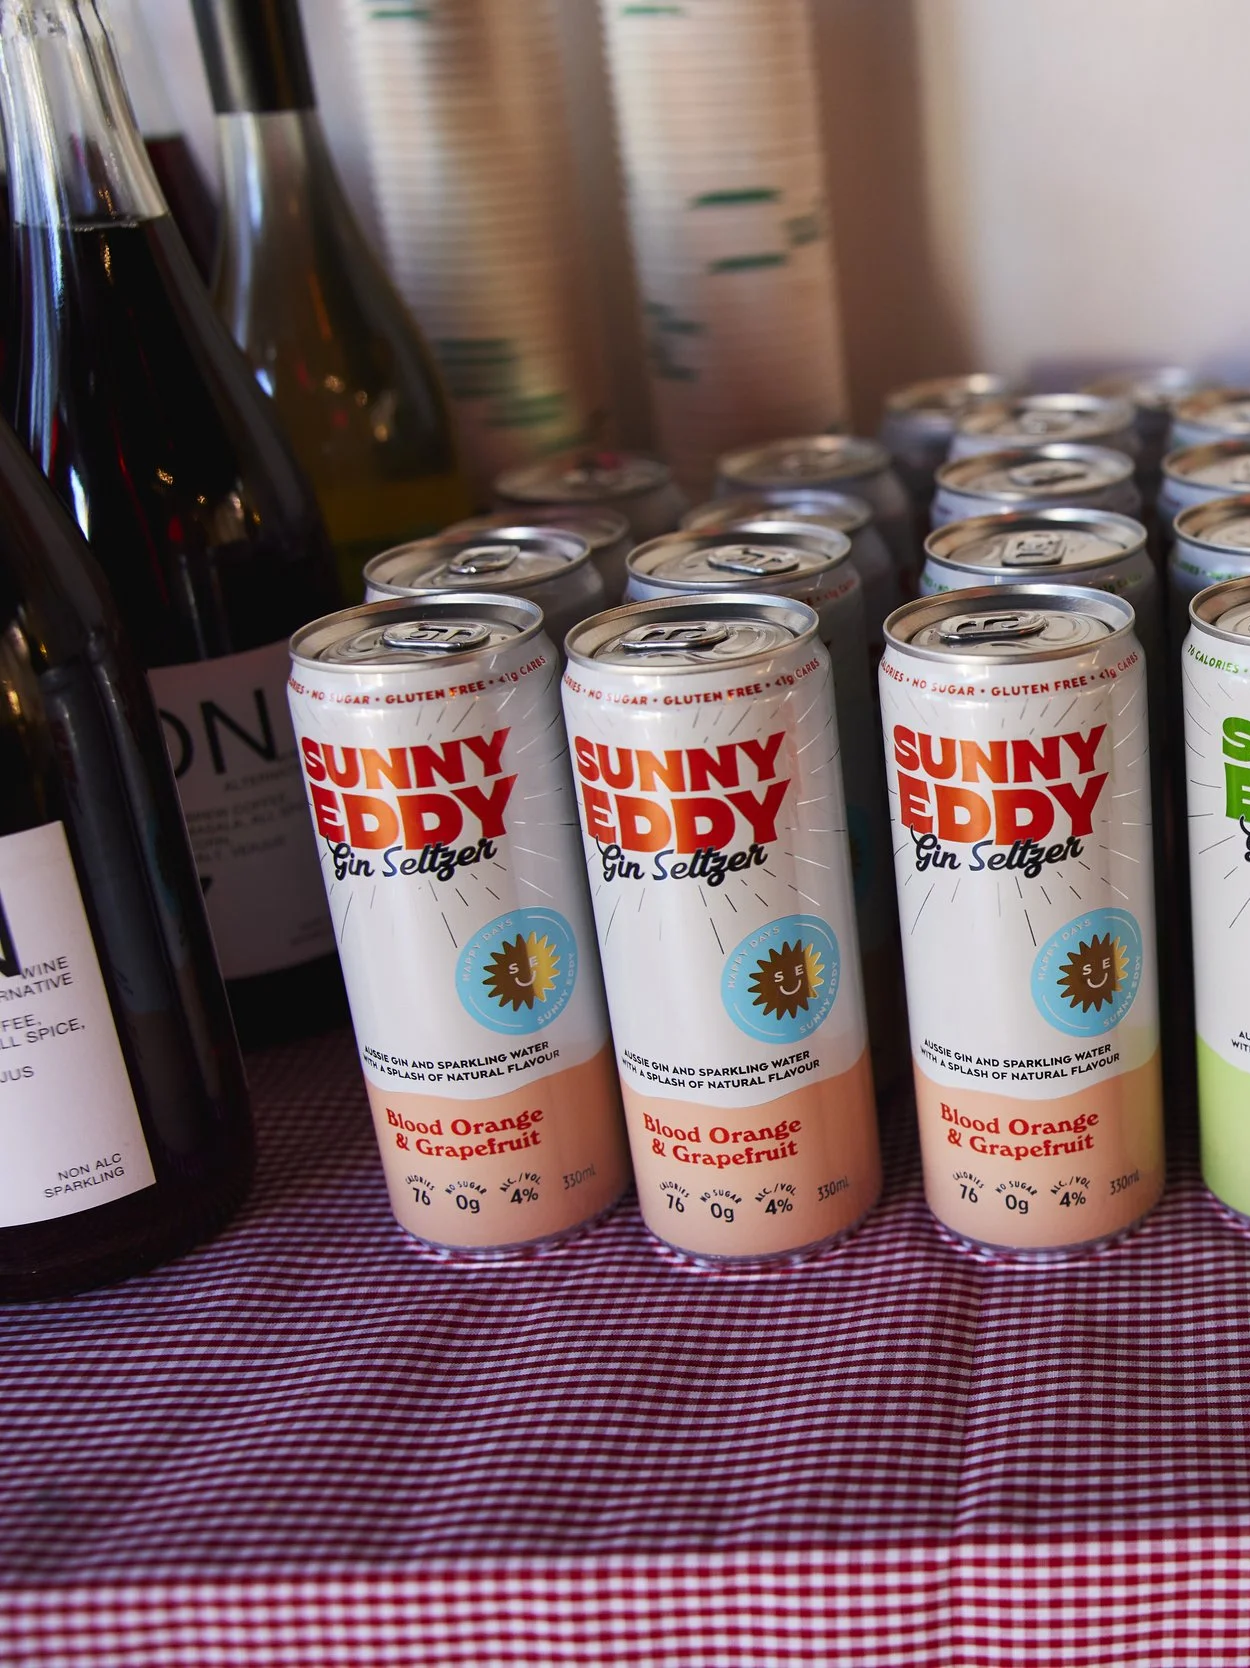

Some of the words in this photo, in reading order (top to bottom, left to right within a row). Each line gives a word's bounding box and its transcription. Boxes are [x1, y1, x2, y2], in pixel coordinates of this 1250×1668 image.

[912, 678, 927, 689] NO
[931, 682, 975, 696] SUGAR
[991, 683, 1049, 696] GLUTEN
[1055, 676, 1087, 691] FREE
[1117, 652, 1138, 672] CARBS
[1195, 651, 1239, 674] CALORIES
[311, 690, 324, 700] NO
[386, 689, 445, 704] GLUTEN
[448, 680, 486, 697] FREE
[520, 655, 546, 676] CARBS
[588, 689, 602, 700] NO
[606, 691, 647, 705] SUGAR
[664, 691, 723, 705] GLUTEN
[727, 683, 762, 699] FREE
[795, 658, 820, 679] CARBS
[301, 727, 511, 789] SUNNY
[575, 731, 786, 791] SUNNY
[894, 724, 1107, 783] SUNNY
[309, 773, 518, 850] EDDY
[580, 779, 791, 854] EDDY
[897, 770, 1109, 845] EDDY
[326, 835, 375, 881] Gin
[382, 838, 497, 882] Seltzer
[596, 836, 645, 882] Gin
[653, 843, 768, 887] Seltzer
[910, 825, 961, 872] Gin
[969, 836, 1084, 878] Seltzer
[21, 956, 69, 979] WINE
[1082, 964, 1092, 976] S
[1102, 957, 1111, 970] E
[26, 1018, 85, 1043] SPICE,
[920, 1045, 939, 1065] WITH
[940, 1059, 946, 1067] A
[948, 1061, 988, 1079] SPLASH
[991, 1070, 1007, 1080] OF
[1011, 1069, 1068, 1081] NATURAL
[1071, 1052, 1120, 1076] FLAVOUR
[924, 1038, 952, 1059] AUSSIE
[954, 1052, 973, 1064] GIN
[976, 1057, 1000, 1067] AND
[1003, 1054, 1073, 1068] SPARKLING
[1075, 1043, 1112, 1061] WATER
[386, 1108, 444, 1136] Blood
[451, 1108, 544, 1136] Orange
[643, 1113, 702, 1143] Blood
[709, 1119, 802, 1144] Orange
[940, 1102, 1001, 1135] Blood
[1008, 1112, 1099, 1136] Orange
[396, 1133, 410, 1152] &
[415, 1129, 541, 1160] Grapefruit
[651, 1138, 666, 1157] &
[672, 1140, 799, 1169] Grapefruit
[947, 1128, 962, 1147] &
[969, 1133, 1095, 1161] Grapefruit
[58, 1163, 90, 1181] NON
[95, 1152, 122, 1171] ALC
[44, 1166, 125, 1199] SPARKLING
[412, 1188, 430, 1206] 76
[510, 1187, 539, 1204] 4%
[960, 1184, 978, 1203] 76
[456, 1194, 480, 1214] 0g
[667, 1194, 685, 1214] 76
[710, 1202, 734, 1223] 0g
[765, 1198, 793, 1215] 4%
[1005, 1194, 1029, 1214] 0g
[1059, 1191, 1086, 1208] 4%
